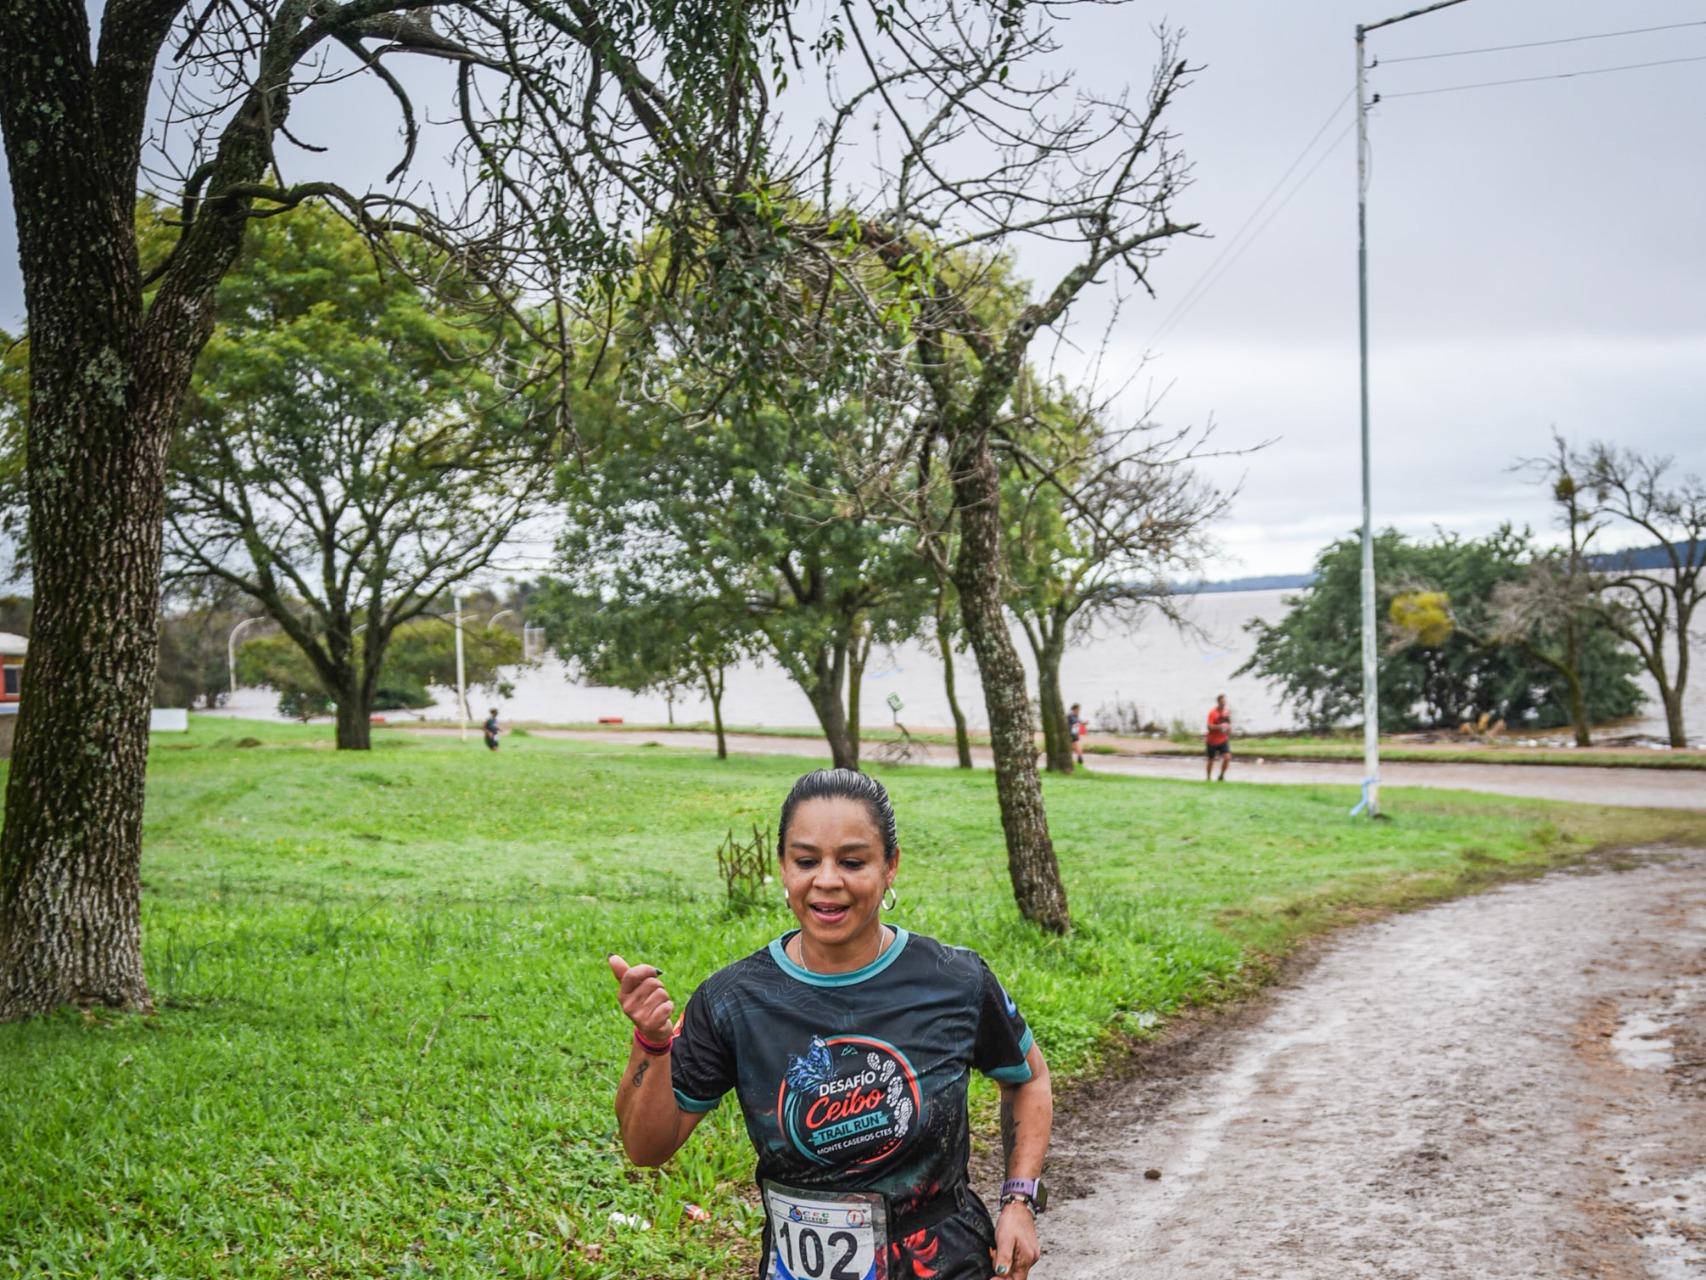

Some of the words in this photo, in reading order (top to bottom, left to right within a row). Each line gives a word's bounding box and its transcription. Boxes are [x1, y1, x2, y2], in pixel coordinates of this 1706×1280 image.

[820, 1070, 876, 1097] DESAFÍO
[806, 1086, 885, 1129] Ceibo
[817, 1141, 843, 1155] MONTE
[843, 1134, 875, 1149] CASEROS
[875, 1127, 893, 1139] CTES
[820, 1124, 853, 1142] TRAIL
[855, 1114, 880, 1131] RUN
[780, 1221, 860, 1280] 102
